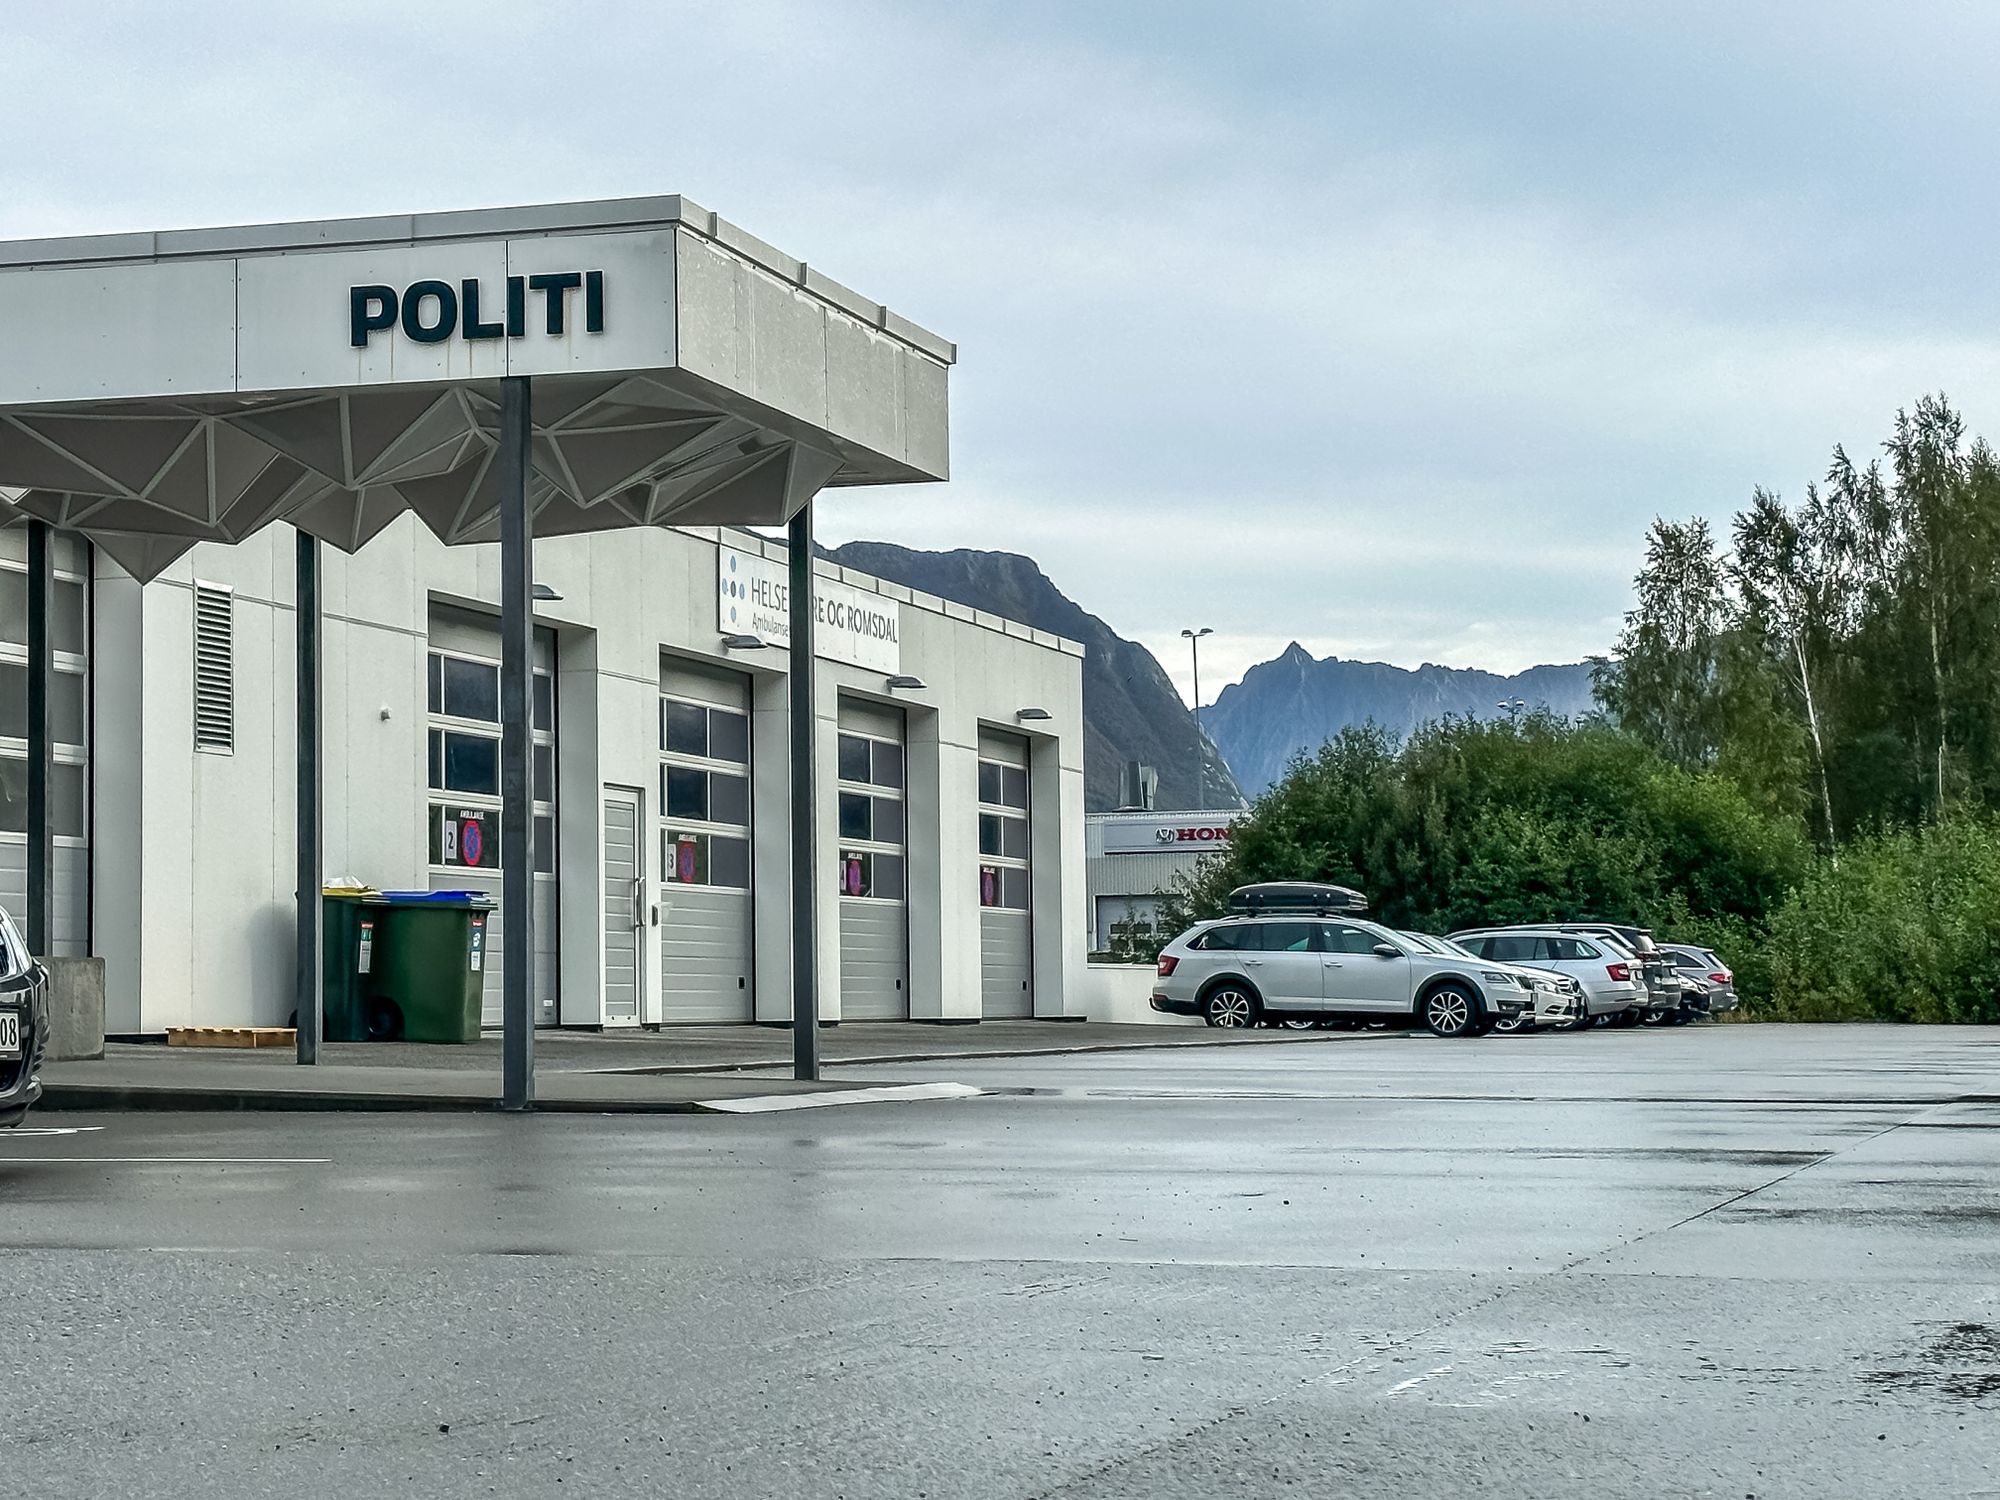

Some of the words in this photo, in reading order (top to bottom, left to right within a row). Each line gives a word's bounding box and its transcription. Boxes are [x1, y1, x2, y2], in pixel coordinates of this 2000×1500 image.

[349, 270, 604, 347] POLITI
[751, 576, 788, 612] HELSE
[827, 600, 844, 629] OG
[847, 605, 898, 643] ROMSDAL
[751, 612, 789, 638] Ambulanse
[448, 831, 454, 850] 2
[1175, 827, 1232, 842] HON
[669, 853, 675, 870] 3
